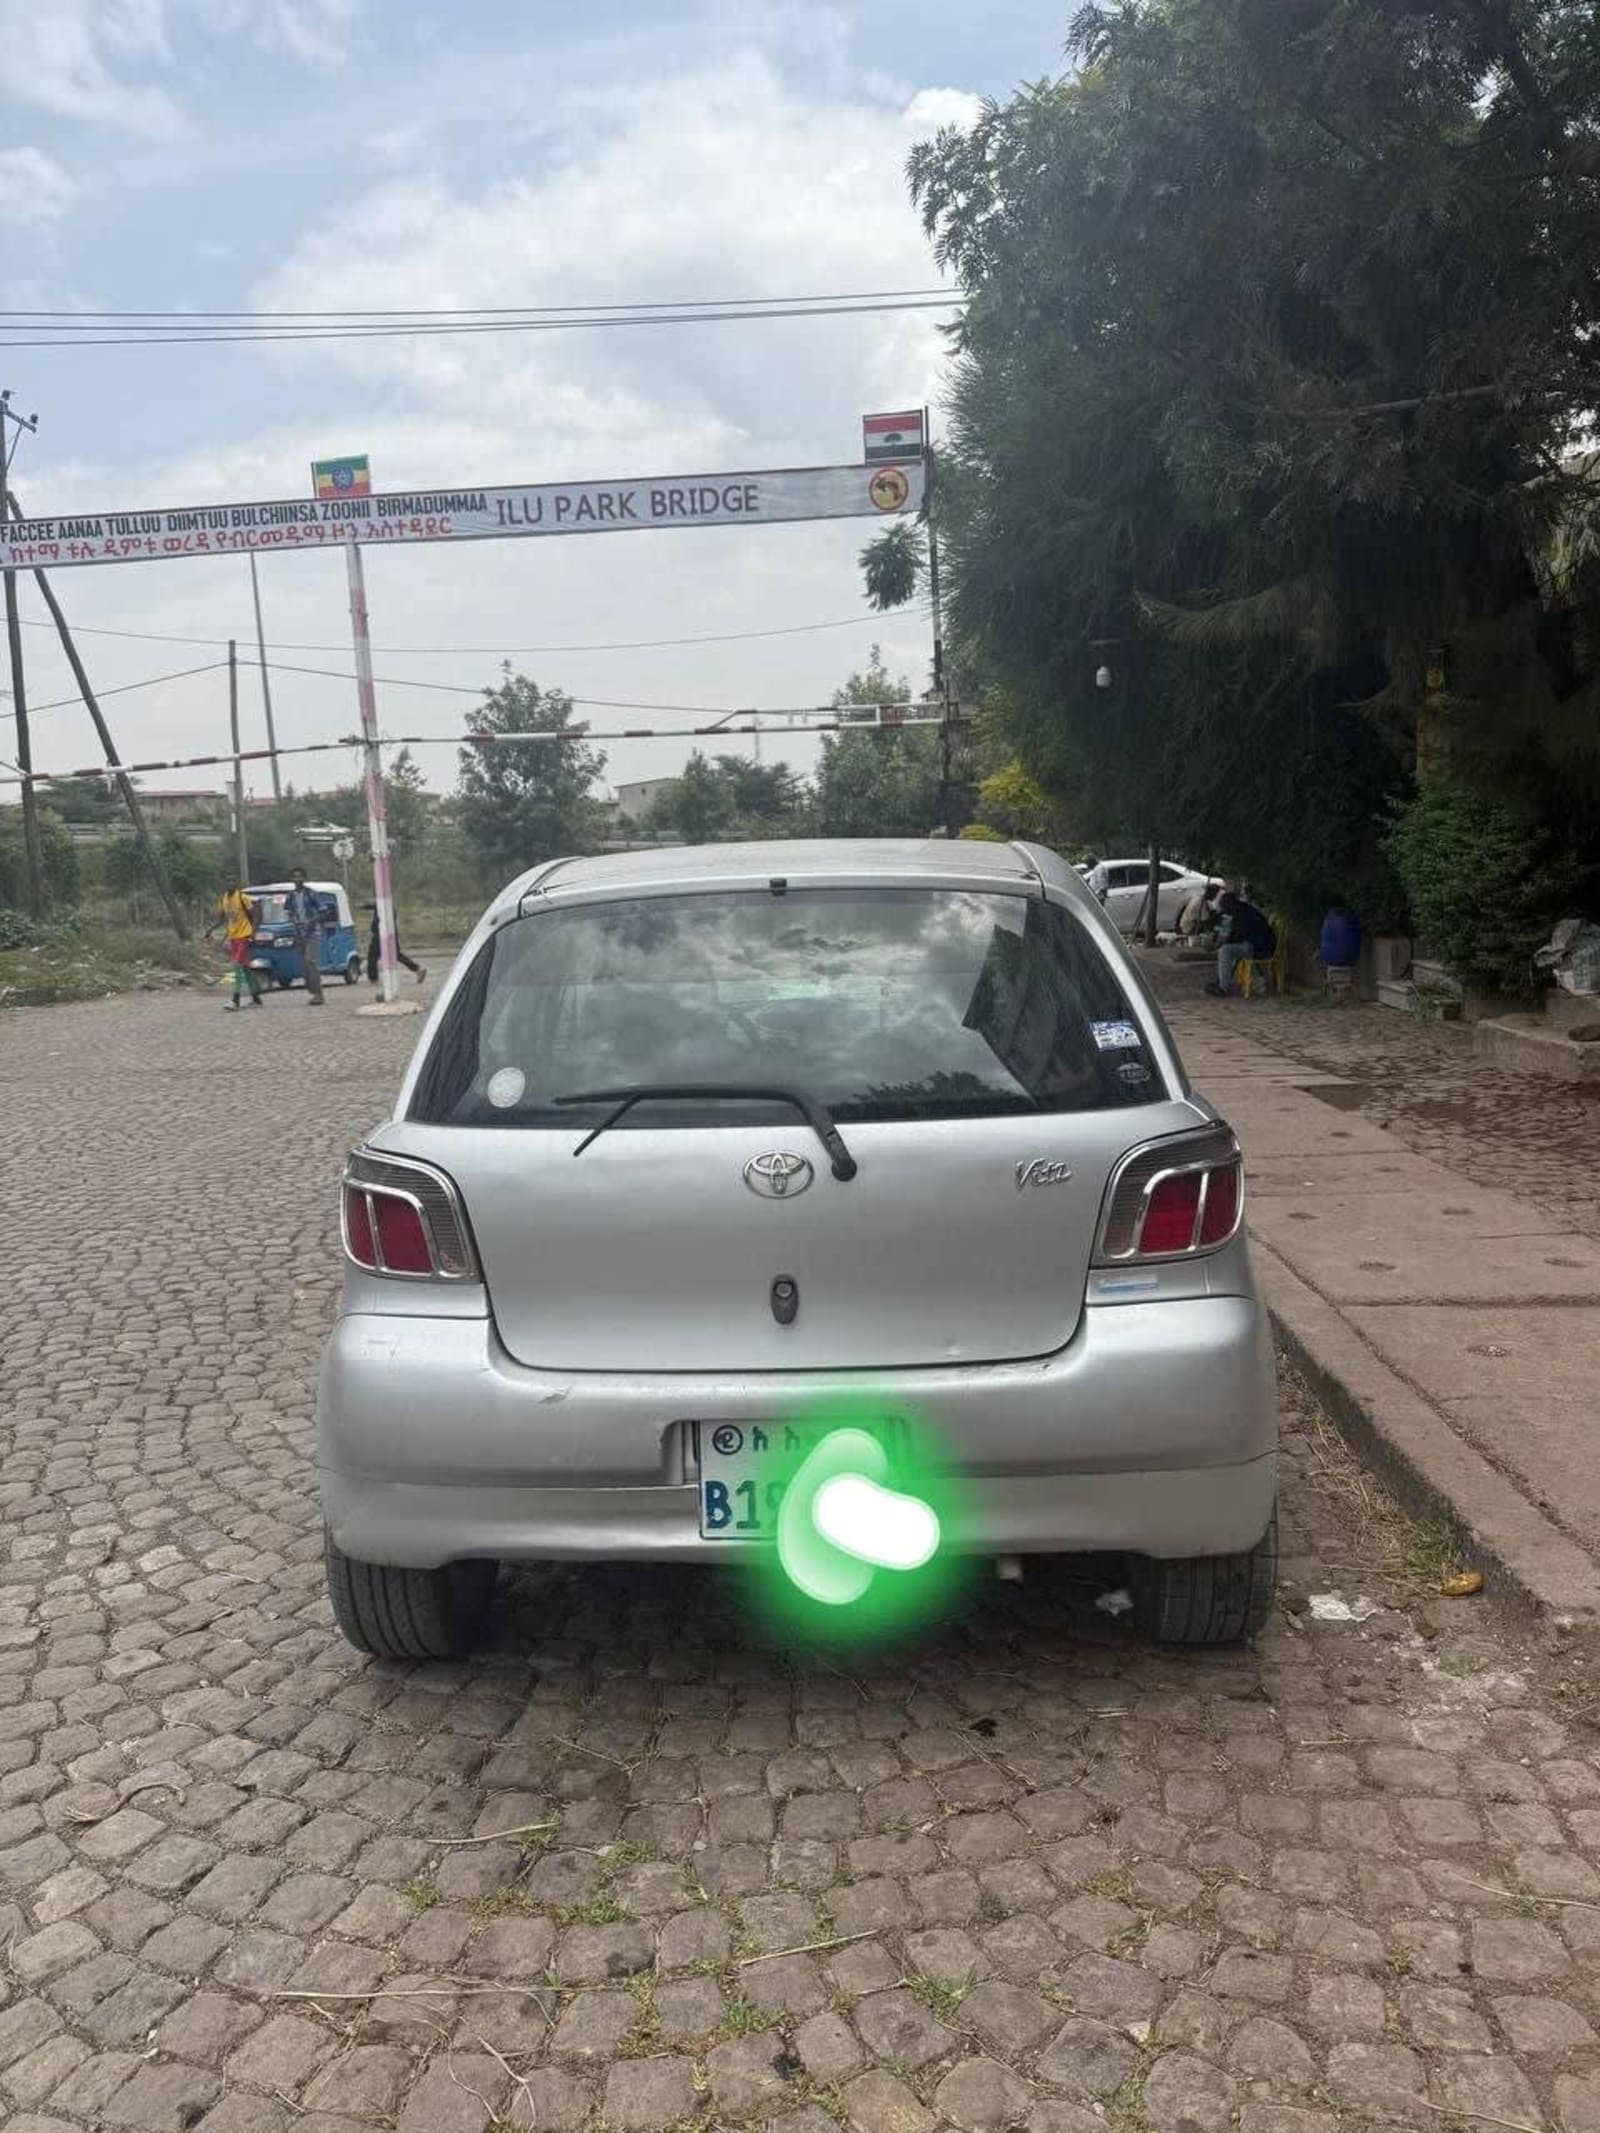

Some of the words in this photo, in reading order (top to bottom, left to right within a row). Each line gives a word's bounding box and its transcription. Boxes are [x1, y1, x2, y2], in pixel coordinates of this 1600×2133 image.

[0, 522, 55, 543] FACCEE
[59, 519, 104, 539] AANAA
[105, 515, 161, 536] TULLUU
[167, 510, 228, 532] DIIMTUU
[231, 503, 319, 527] BULCHIINSA
[321, 499, 371, 521] ZOONII
[377, 492, 488, 517] BIRMADUMMAA
[497, 497, 542, 526] ILU
[555, 492, 637, 521] PARK
[650, 484, 760, 518] BRIDGE
[9, 543, 60, 563] ከተማ
[163, 532, 210, 552] ወረዳ
